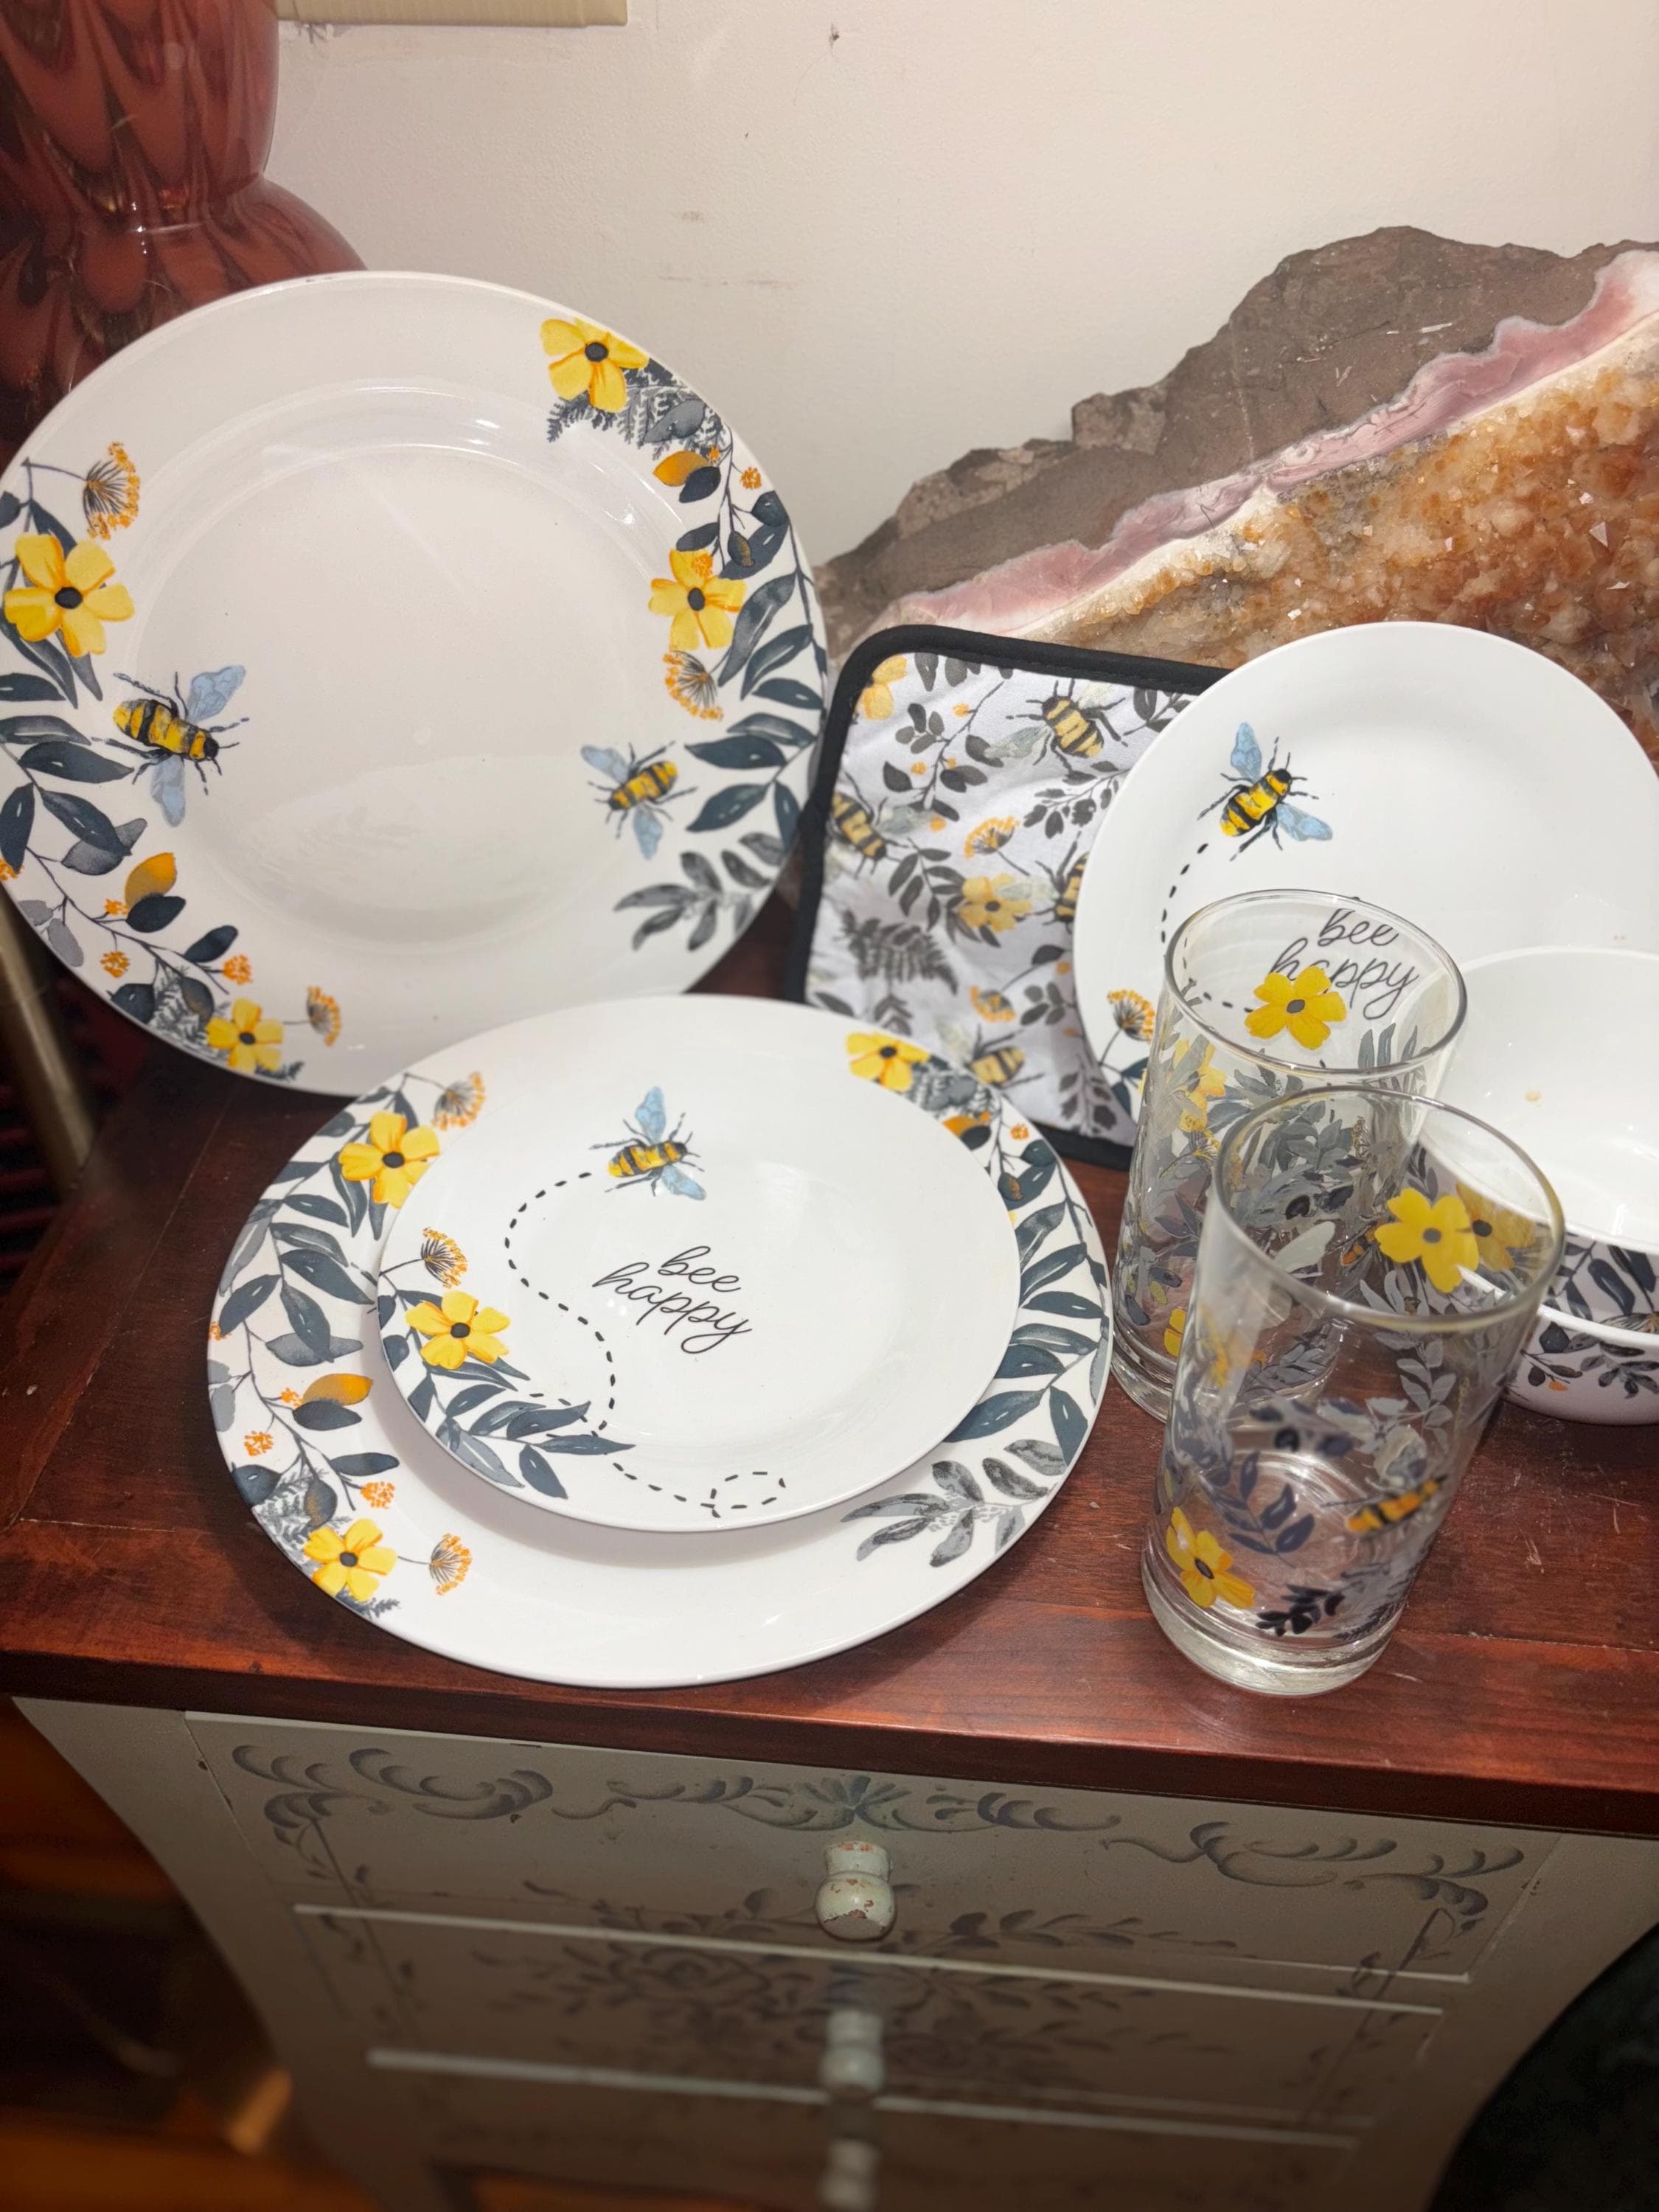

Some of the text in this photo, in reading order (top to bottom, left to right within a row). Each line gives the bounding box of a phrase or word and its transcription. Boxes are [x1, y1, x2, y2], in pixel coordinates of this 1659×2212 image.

[1318, 904, 1399, 947] bee
[657, 1245, 742, 1293] bee
[591, 1262, 753, 1354] happy
